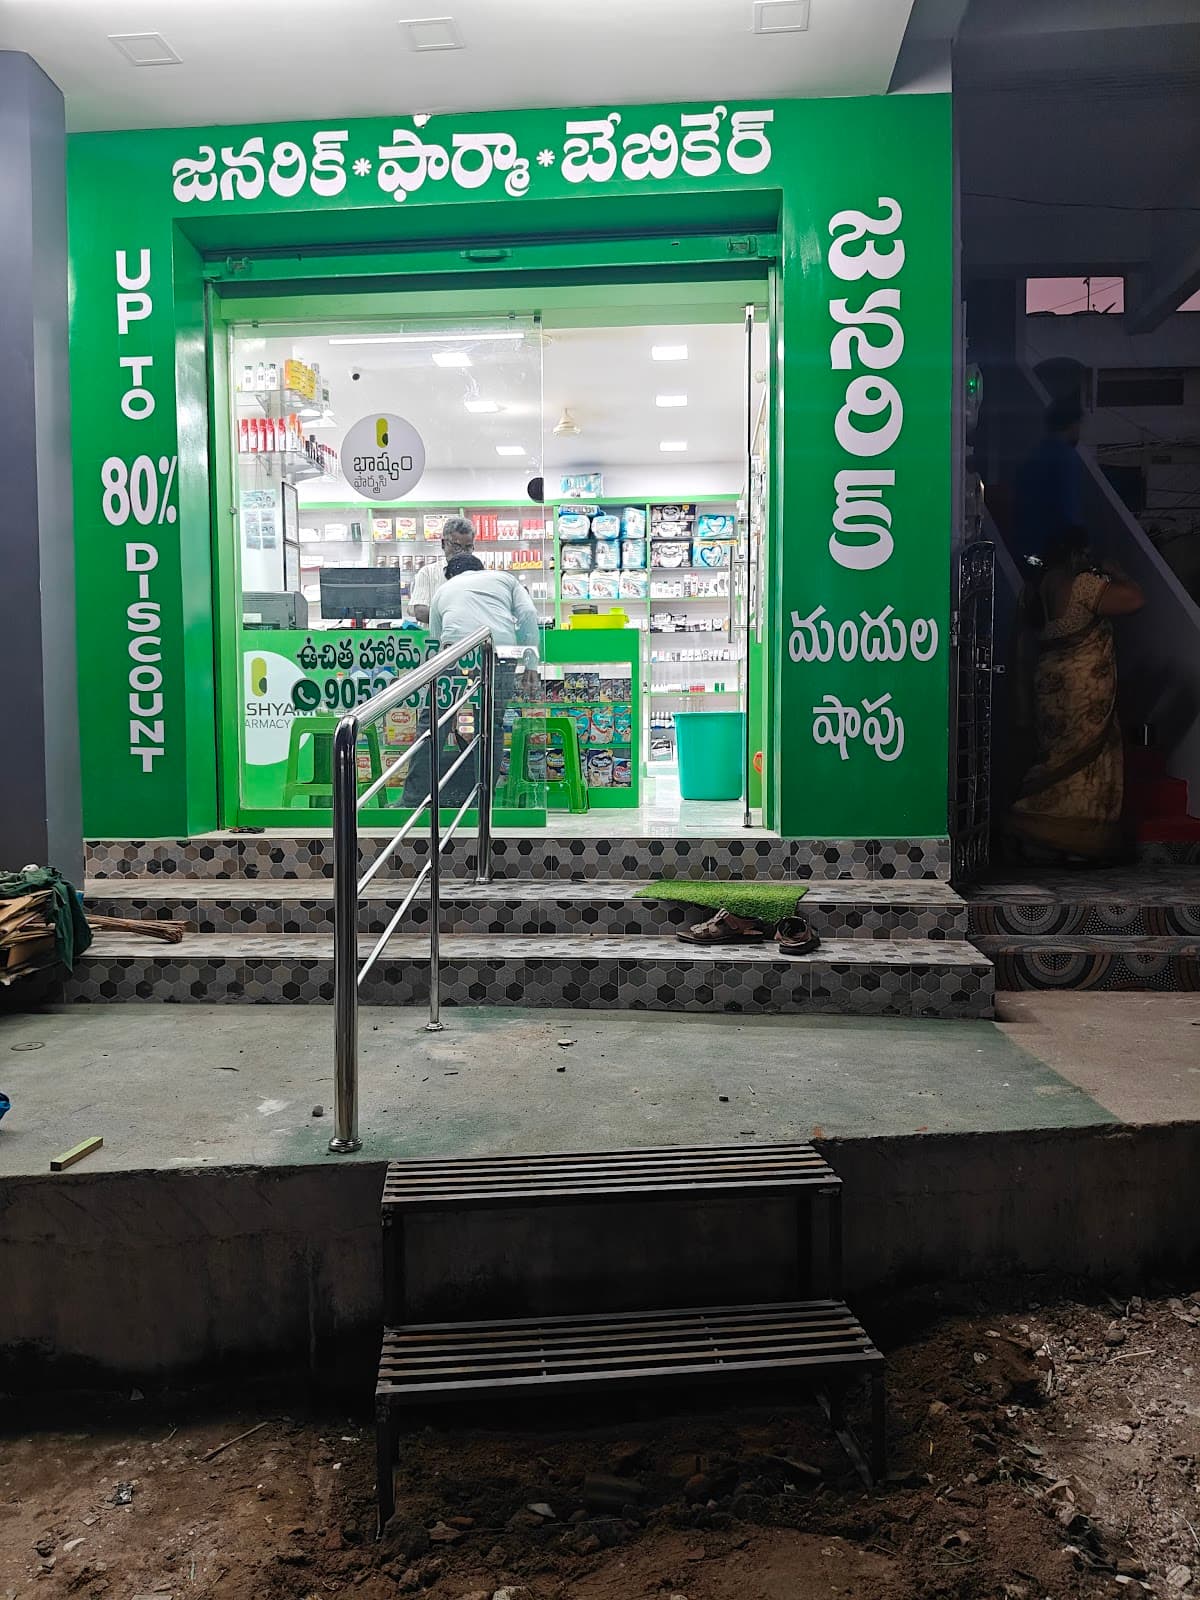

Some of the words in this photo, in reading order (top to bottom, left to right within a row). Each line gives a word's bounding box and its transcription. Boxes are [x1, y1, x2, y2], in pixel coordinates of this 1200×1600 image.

[172, 130, 349, 203] జనరిక్
[377, 128, 531, 203] ఫార్మా
[560, 105, 774, 184] బేబికేర్
[115, 248, 153, 335] UP
[119, 355, 156, 420] TO
[827, 196, 906, 571] జనరిక్
[101, 454, 178, 526] 80%
[353, 451, 413, 481] భాష్యం
[125, 542, 165, 773] DISCOUNT
[297, 637, 354, 670] ఉచిత
[360, 635, 422, 670] హోమ్
[788, 604, 939, 662] మందుల
[325, 677, 482, 710] 9052374
[812, 692, 905, 762] షాపు
